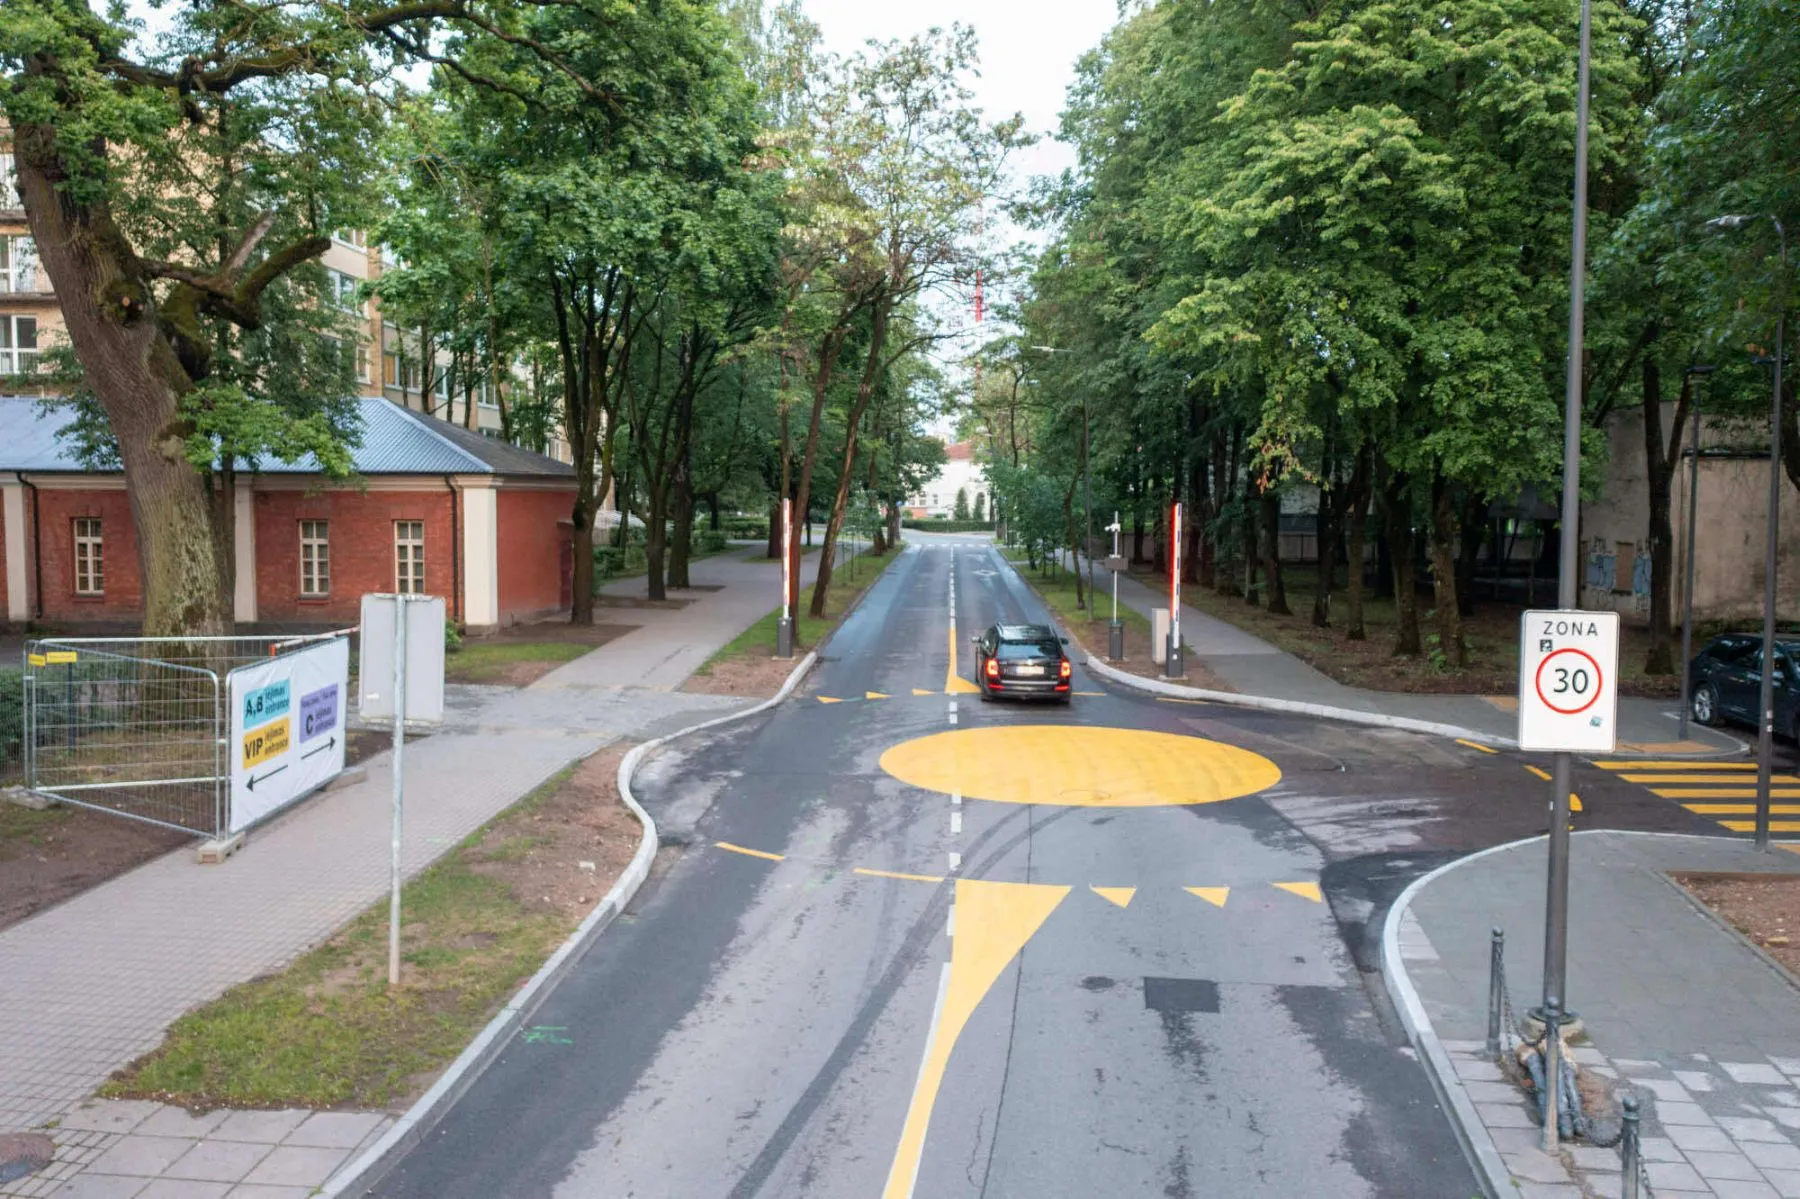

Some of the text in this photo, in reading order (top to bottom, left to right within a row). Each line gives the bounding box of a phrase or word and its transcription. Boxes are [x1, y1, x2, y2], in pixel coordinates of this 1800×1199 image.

[1543, 621, 1598, 636] ZONA
[1553, 668, 1588, 694] 30
[306, 713, 314, 735] C
[245, 737, 263, 760] VIP
